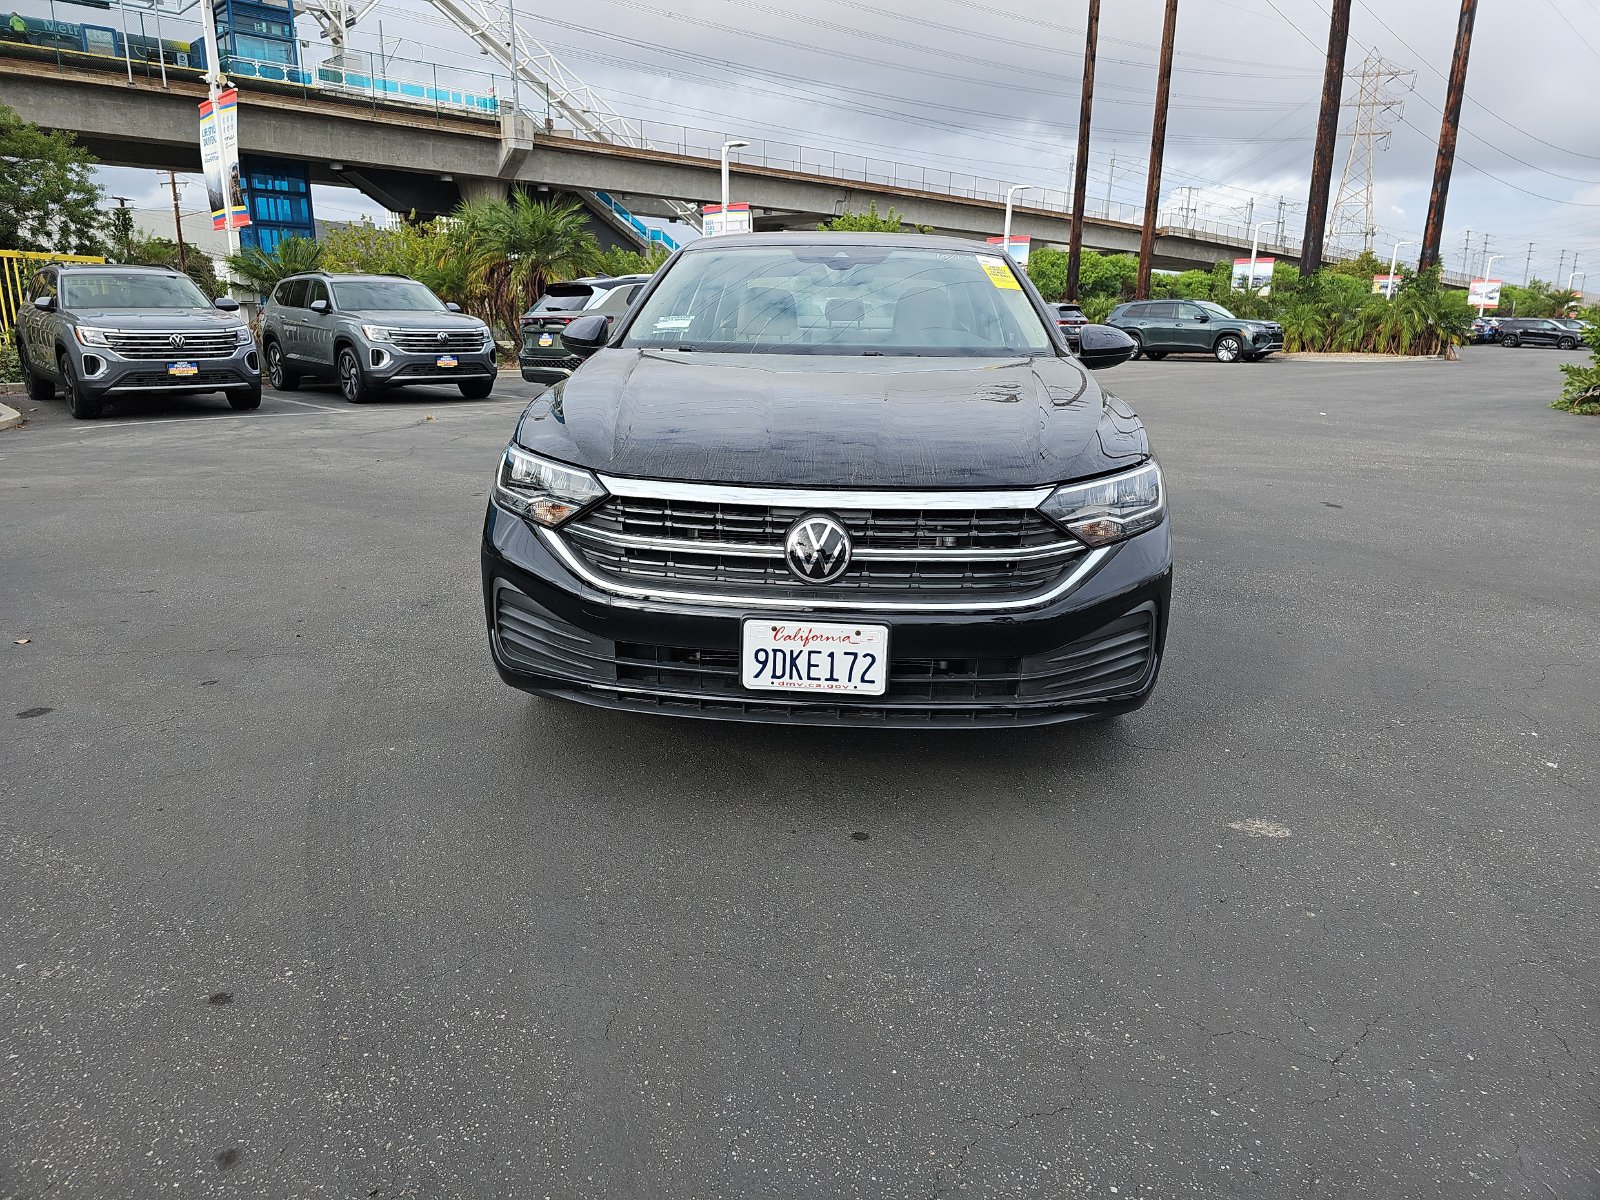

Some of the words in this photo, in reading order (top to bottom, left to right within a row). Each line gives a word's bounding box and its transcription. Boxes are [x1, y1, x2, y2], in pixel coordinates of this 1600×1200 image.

[43, 19, 81, 36] Metr
[772, 626, 860, 648] California
[753, 648, 877, 684] 9DKE172
[778, 681, 849, 690] dmv.ca.gov
